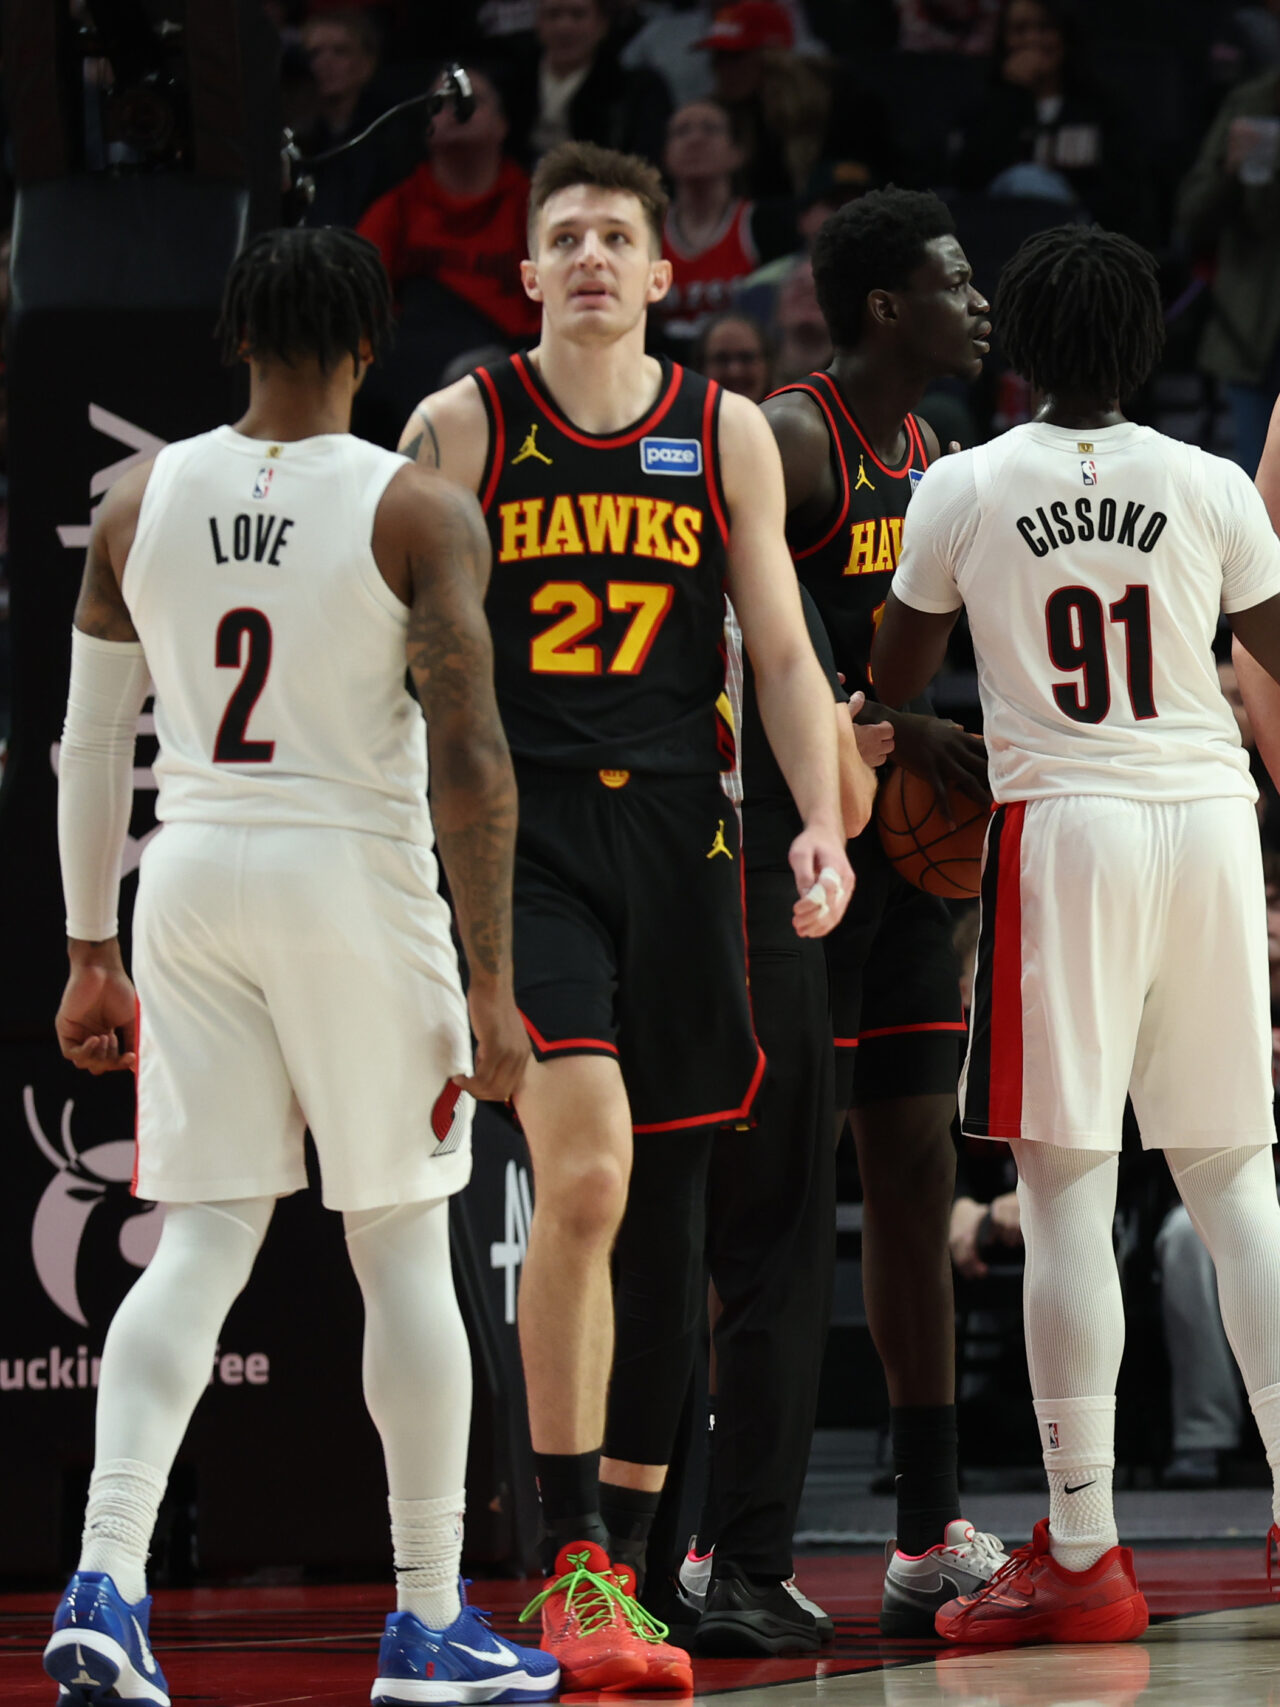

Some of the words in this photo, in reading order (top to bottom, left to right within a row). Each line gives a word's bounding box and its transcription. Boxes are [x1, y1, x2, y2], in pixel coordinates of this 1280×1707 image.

[647, 447, 695, 465] paze
[209, 513, 294, 566] LOVE
[498, 493, 704, 568] HAWKS
[1016, 498, 1168, 557] CISSOKO
[529, 580, 675, 676] 27
[1045, 584, 1159, 724] 91
[212, 606, 276, 763] 2
